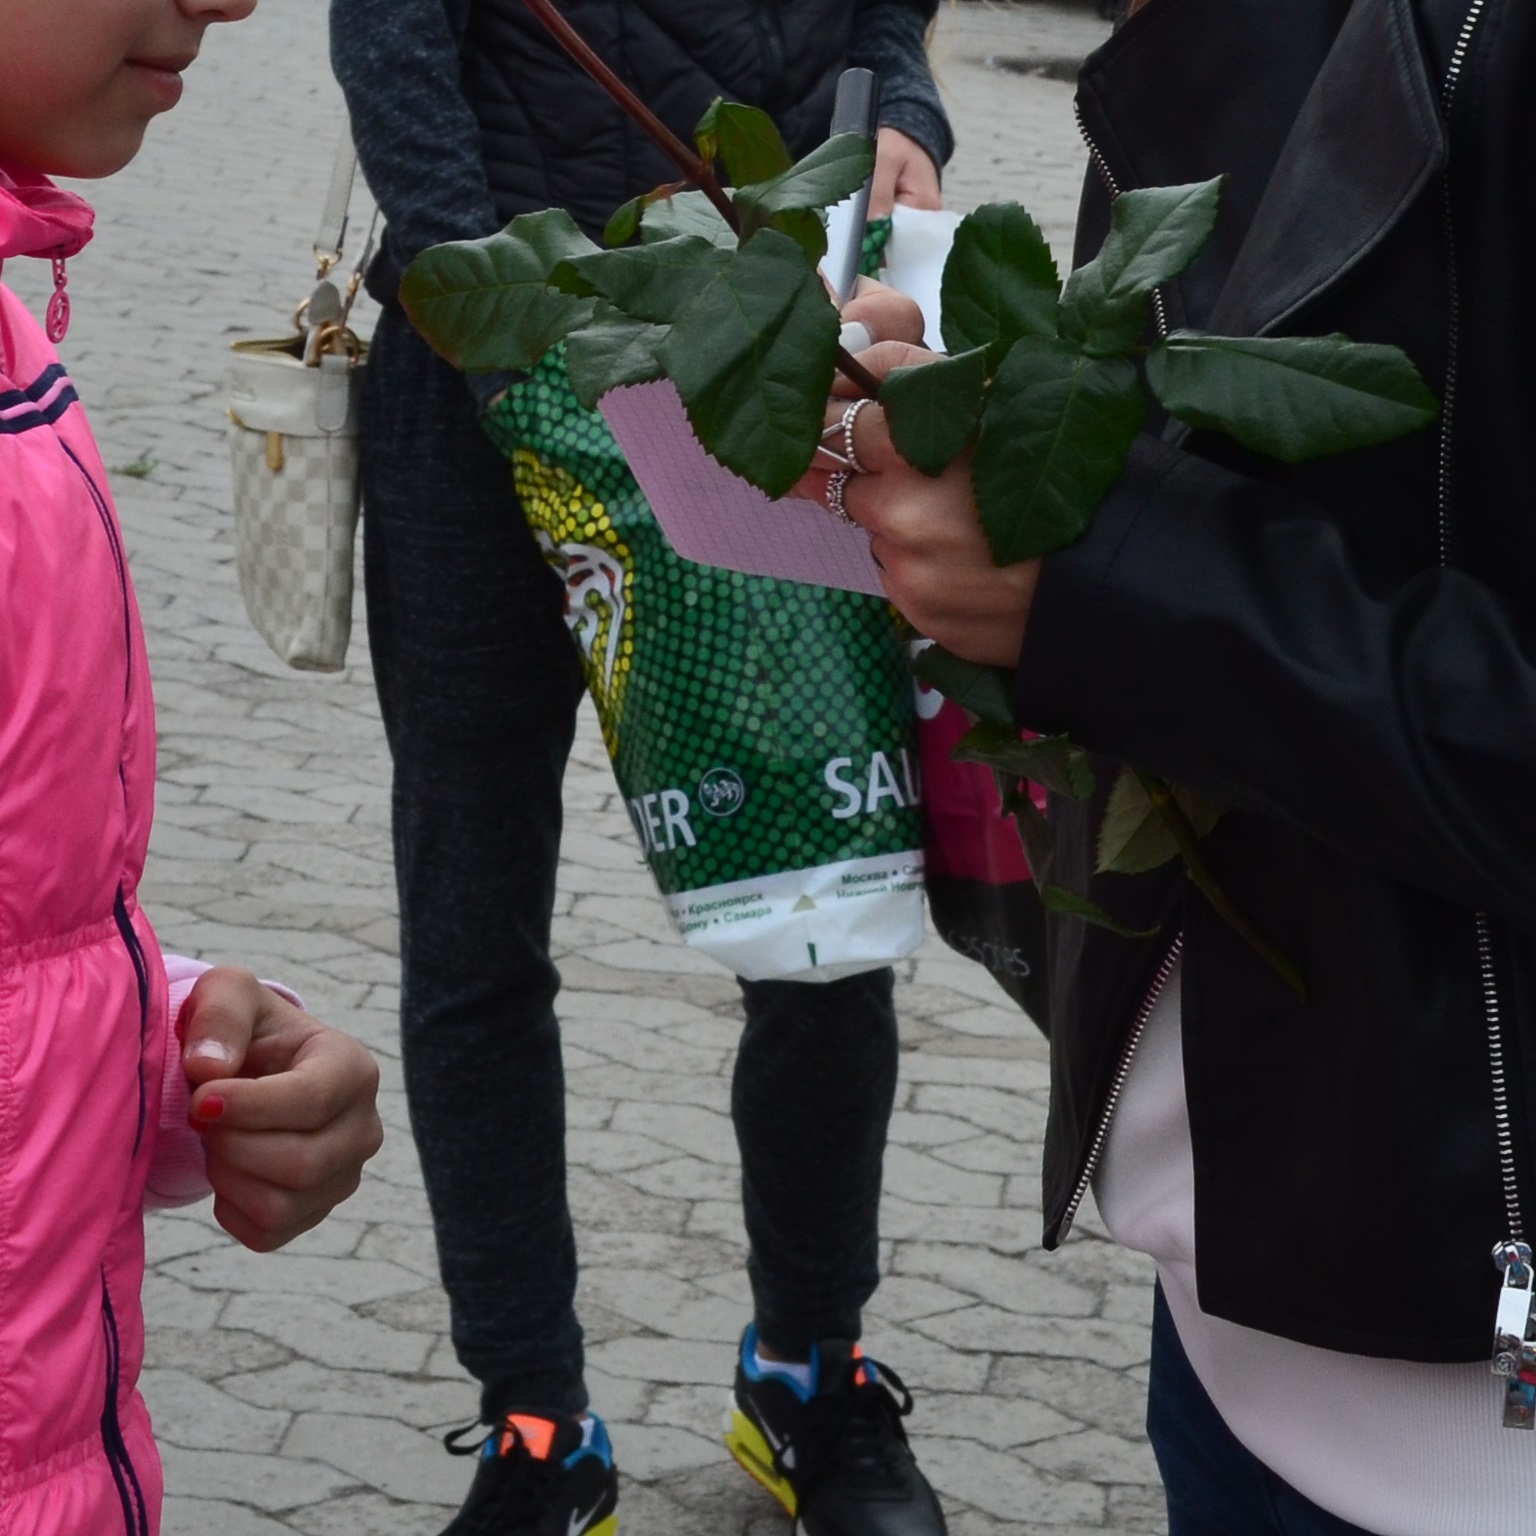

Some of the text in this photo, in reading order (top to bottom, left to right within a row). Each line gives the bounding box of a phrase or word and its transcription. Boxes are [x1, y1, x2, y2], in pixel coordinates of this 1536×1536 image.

[823, 749, 922, 818] SAL
[688, 893, 763, 915] Красноярск
[723, 906, 773, 923] Самара
